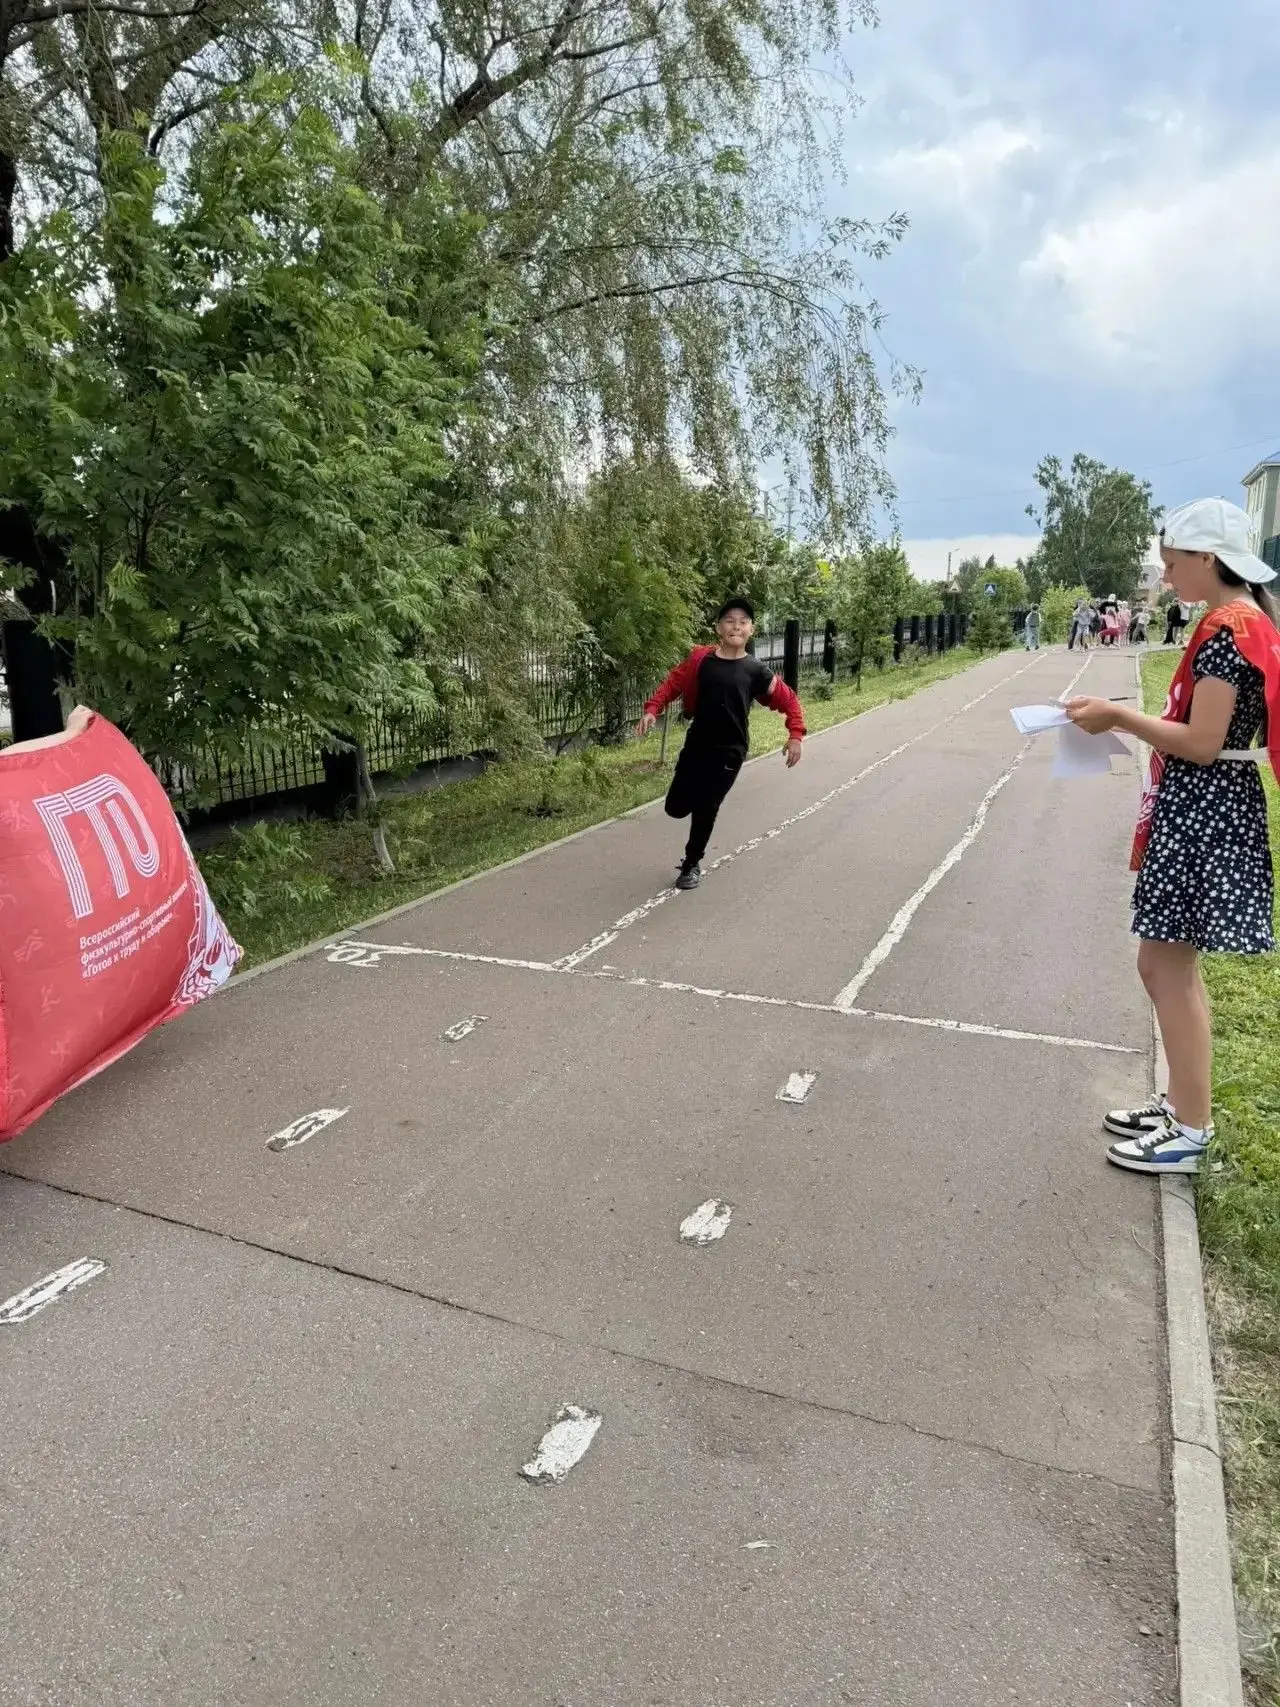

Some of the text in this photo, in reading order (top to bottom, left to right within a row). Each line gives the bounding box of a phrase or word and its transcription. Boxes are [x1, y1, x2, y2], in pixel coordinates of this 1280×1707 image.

[33, 773, 160, 919] ГТО
[80, 906, 140, 949] Всероссийский
[120, 938, 140, 959] труду
